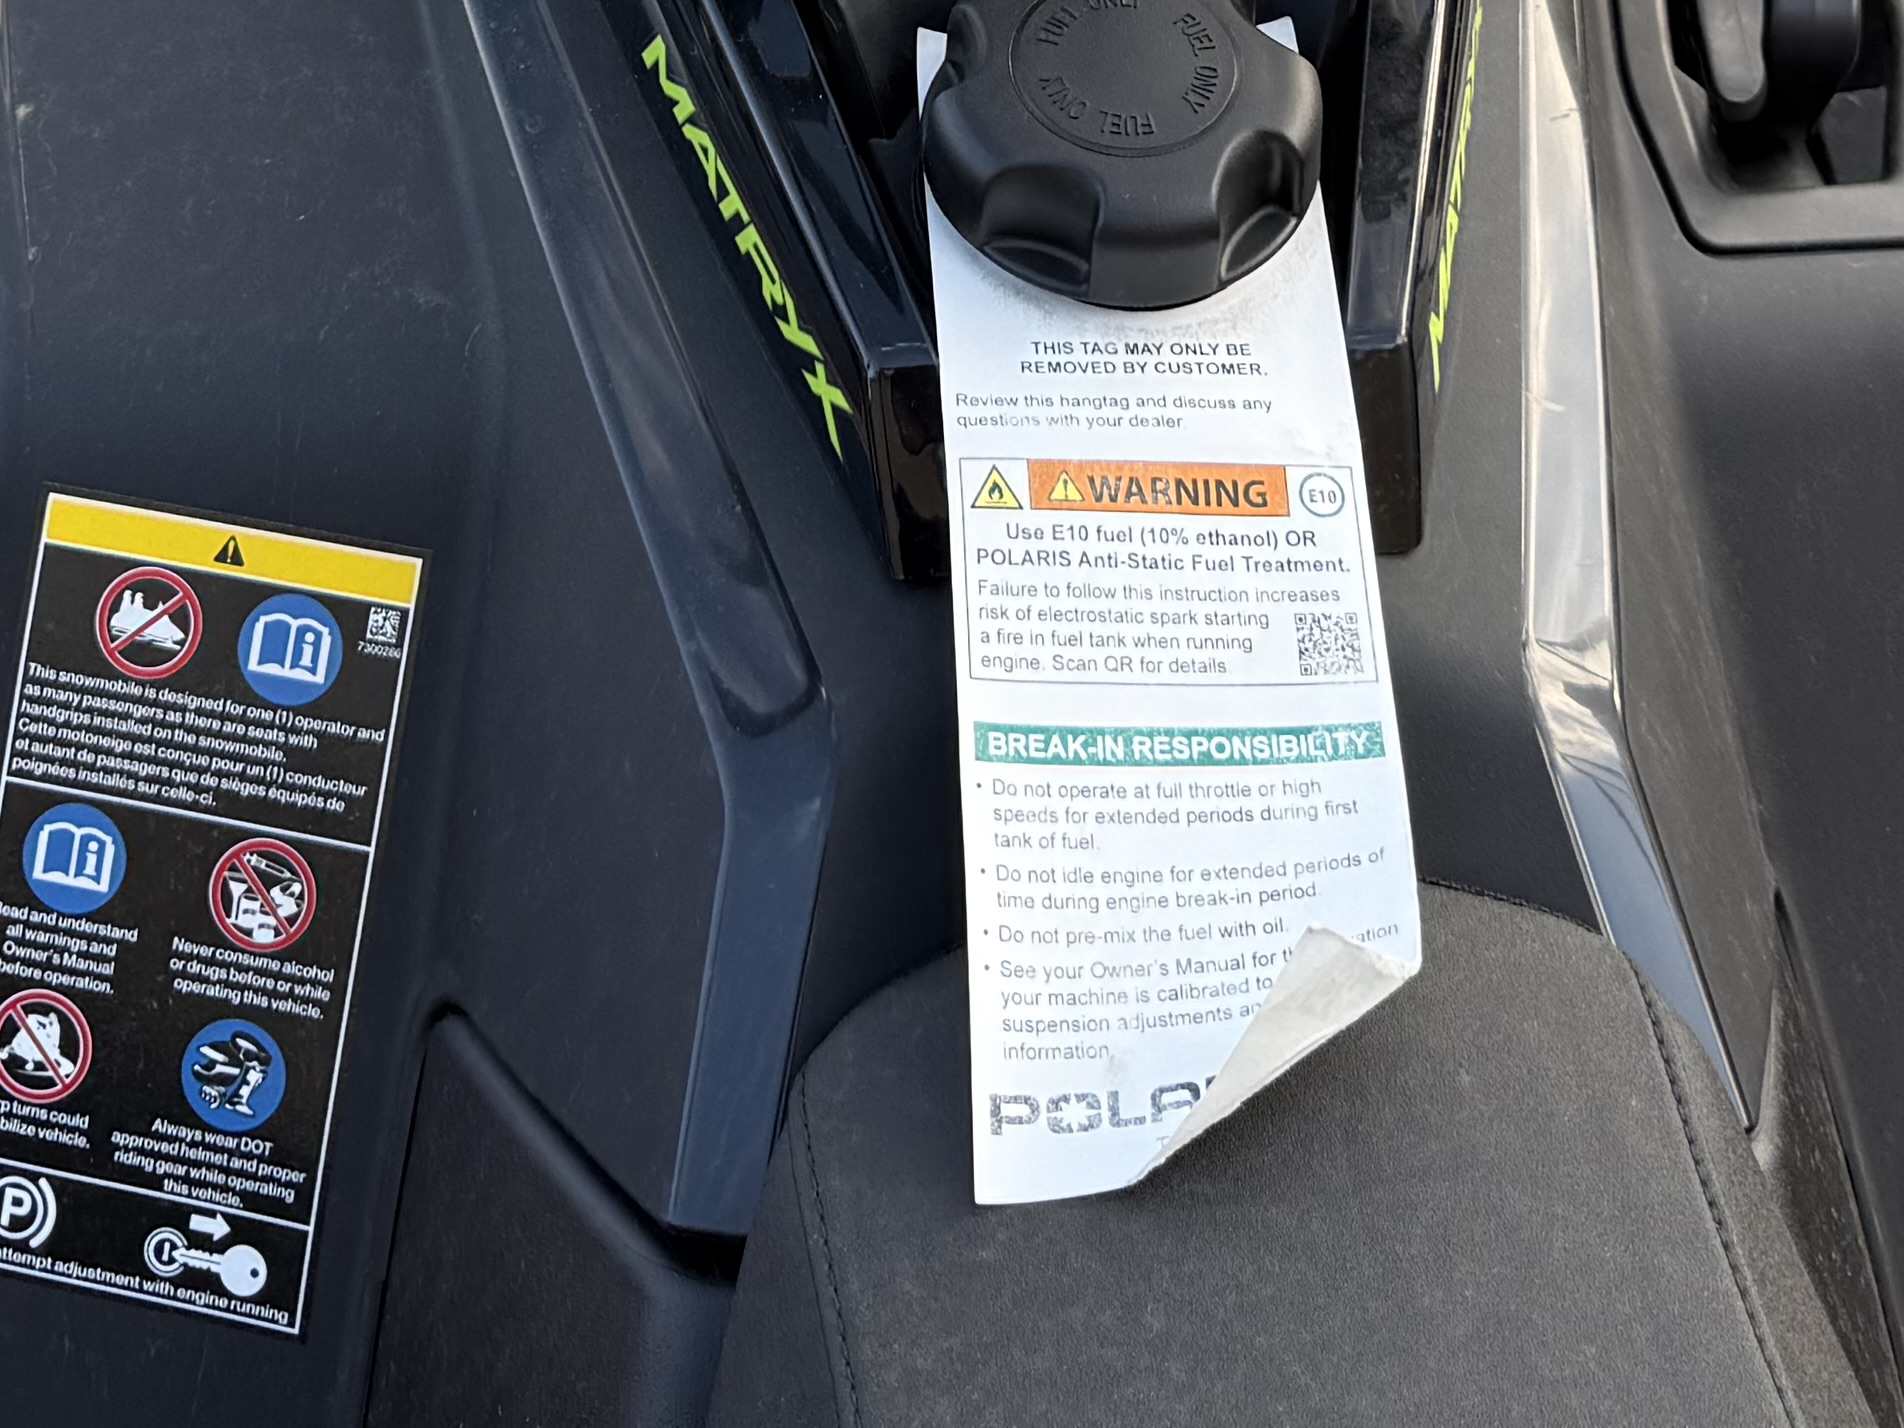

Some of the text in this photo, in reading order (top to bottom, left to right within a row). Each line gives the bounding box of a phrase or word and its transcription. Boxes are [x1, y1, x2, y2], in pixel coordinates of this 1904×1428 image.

[1037, 5, 1081, 47] FUEL
[1173, 12, 1221, 115] FUEL ONLY
[1036, 72, 1156, 137] FUEL ONLY
[641, 33, 854, 463] MATRYX
[1029, 340, 1252, 356] THIS TAG MAY ONLY BE
[1020, 360, 1268, 376] REMOVED BY CUSTOMER.
[1086, 474, 1269, 509] WARNING
[1307, 487, 1338, 505] E10
[1005, 521, 1317, 551] Use E10 fuel (10% ethanol) OR
[975, 547, 1351, 573] POLARIS Anti-Static Fuel Treatment.
[977, 578, 1340, 603] Failure to follow this instruction increases
[978, 603, 1270, 630] risk of electrostatic spark starting
[979, 626, 1253, 654] a fire in fuel tank when running
[980, 654, 1045, 673] engine.
[1051, 653, 1098, 672] Scan
[1103, 654, 1134, 673] QR
[1139, 655, 1163, 674] for
[27, 660, 386, 742] This snowmobile is designed for one (1) operator and
[987, 730, 1370, 761] BREAK-IN RESPONSIBILITY
[4, 922, 118, 957] all warnings and
[28, 909, 58, 926] and
[56, 915, 139, 942] understand
[1, 939, 115, 975] Owner's Manual
[171, 935, 335, 983] Never consume alcohol
[42, 969, 114, 995] operation.
[168, 956, 331, 1002] or drugs before or while
[172, 976, 324, 1020] operating this vehicle.
[11, 1099, 48, 1121] turns
[48, 1109, 90, 1130] could
[988, 1081, 1201, 1136] POLA
[36, 1126, 90, 1149] vehicle.
[52, 1259, 140, 1289] adjustment
[141, 1278, 175, 1297] with
[175, 1286, 229, 1308] engine
[228, 1298, 289, 1325] running
